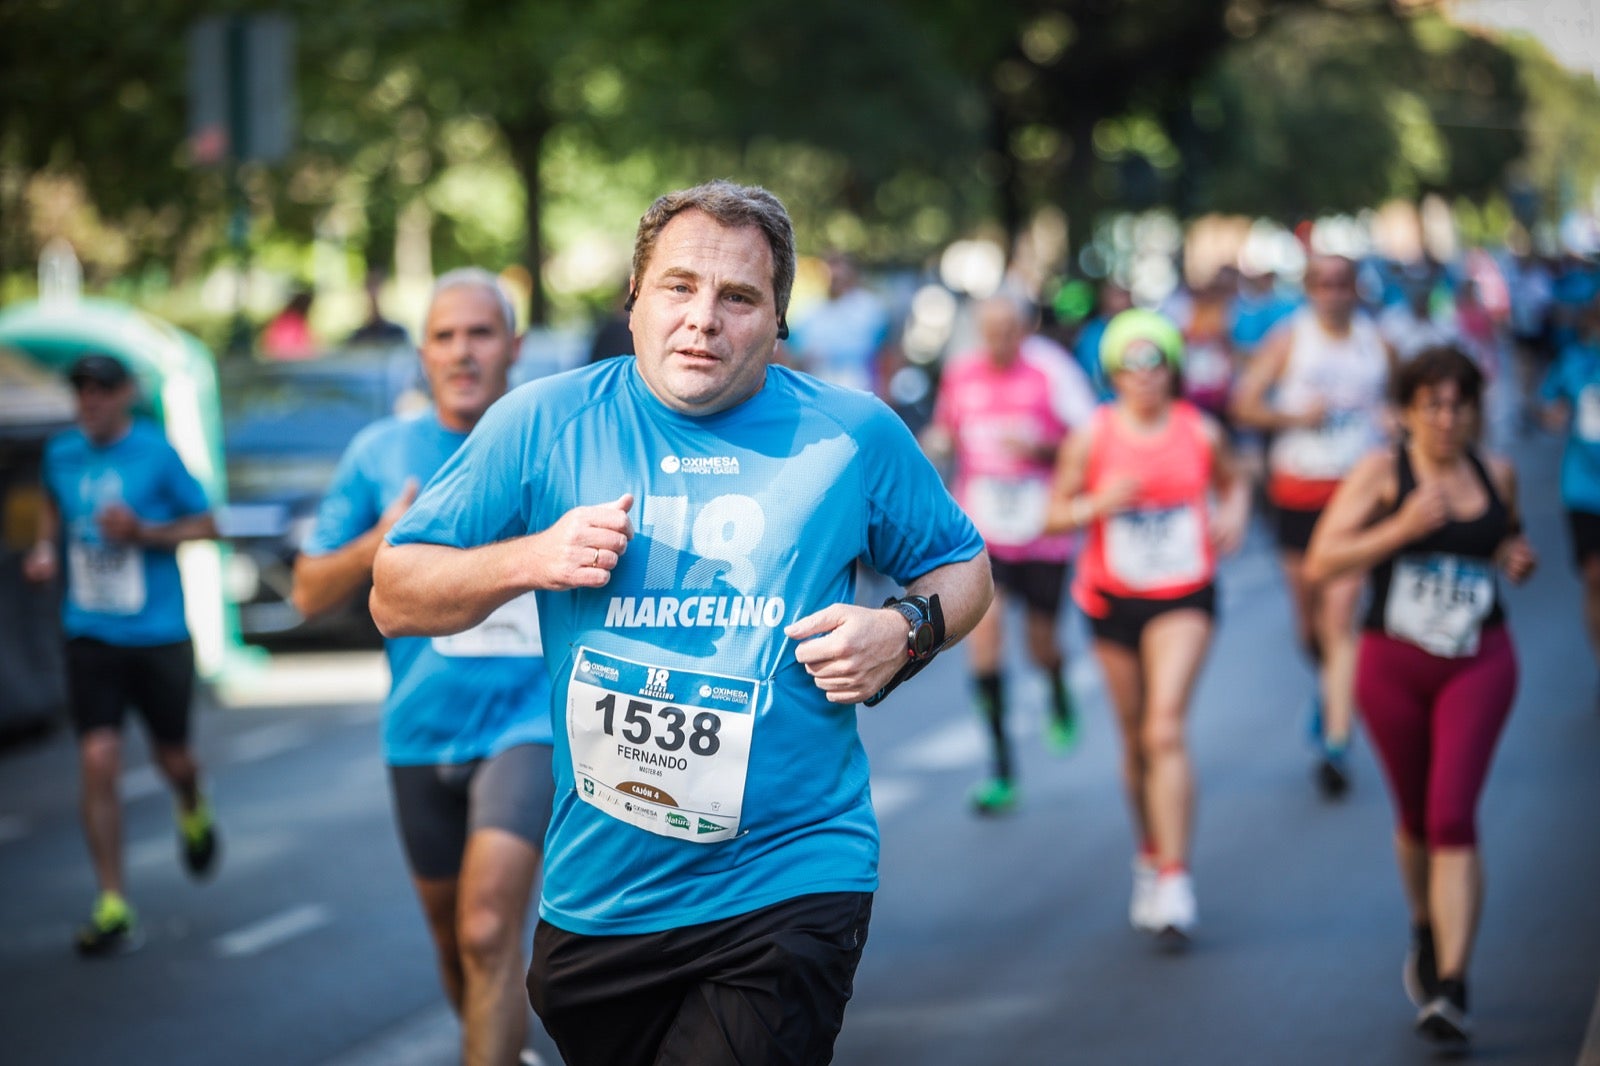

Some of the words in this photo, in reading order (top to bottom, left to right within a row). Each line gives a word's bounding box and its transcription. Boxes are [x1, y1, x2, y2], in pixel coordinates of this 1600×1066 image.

[681, 456, 739, 467] OXIMESA
[642, 493, 765, 595] 18
[604, 596, 786, 628] MARCELINO
[591, 662, 619, 675] OXIMESA
[646, 667, 669, 688] 18
[712, 686, 748, 698] OXIMESA
[595, 693, 722, 756] 1538
[617, 744, 688, 771] FERNANDO
[653, 791, 660, 800] 4
